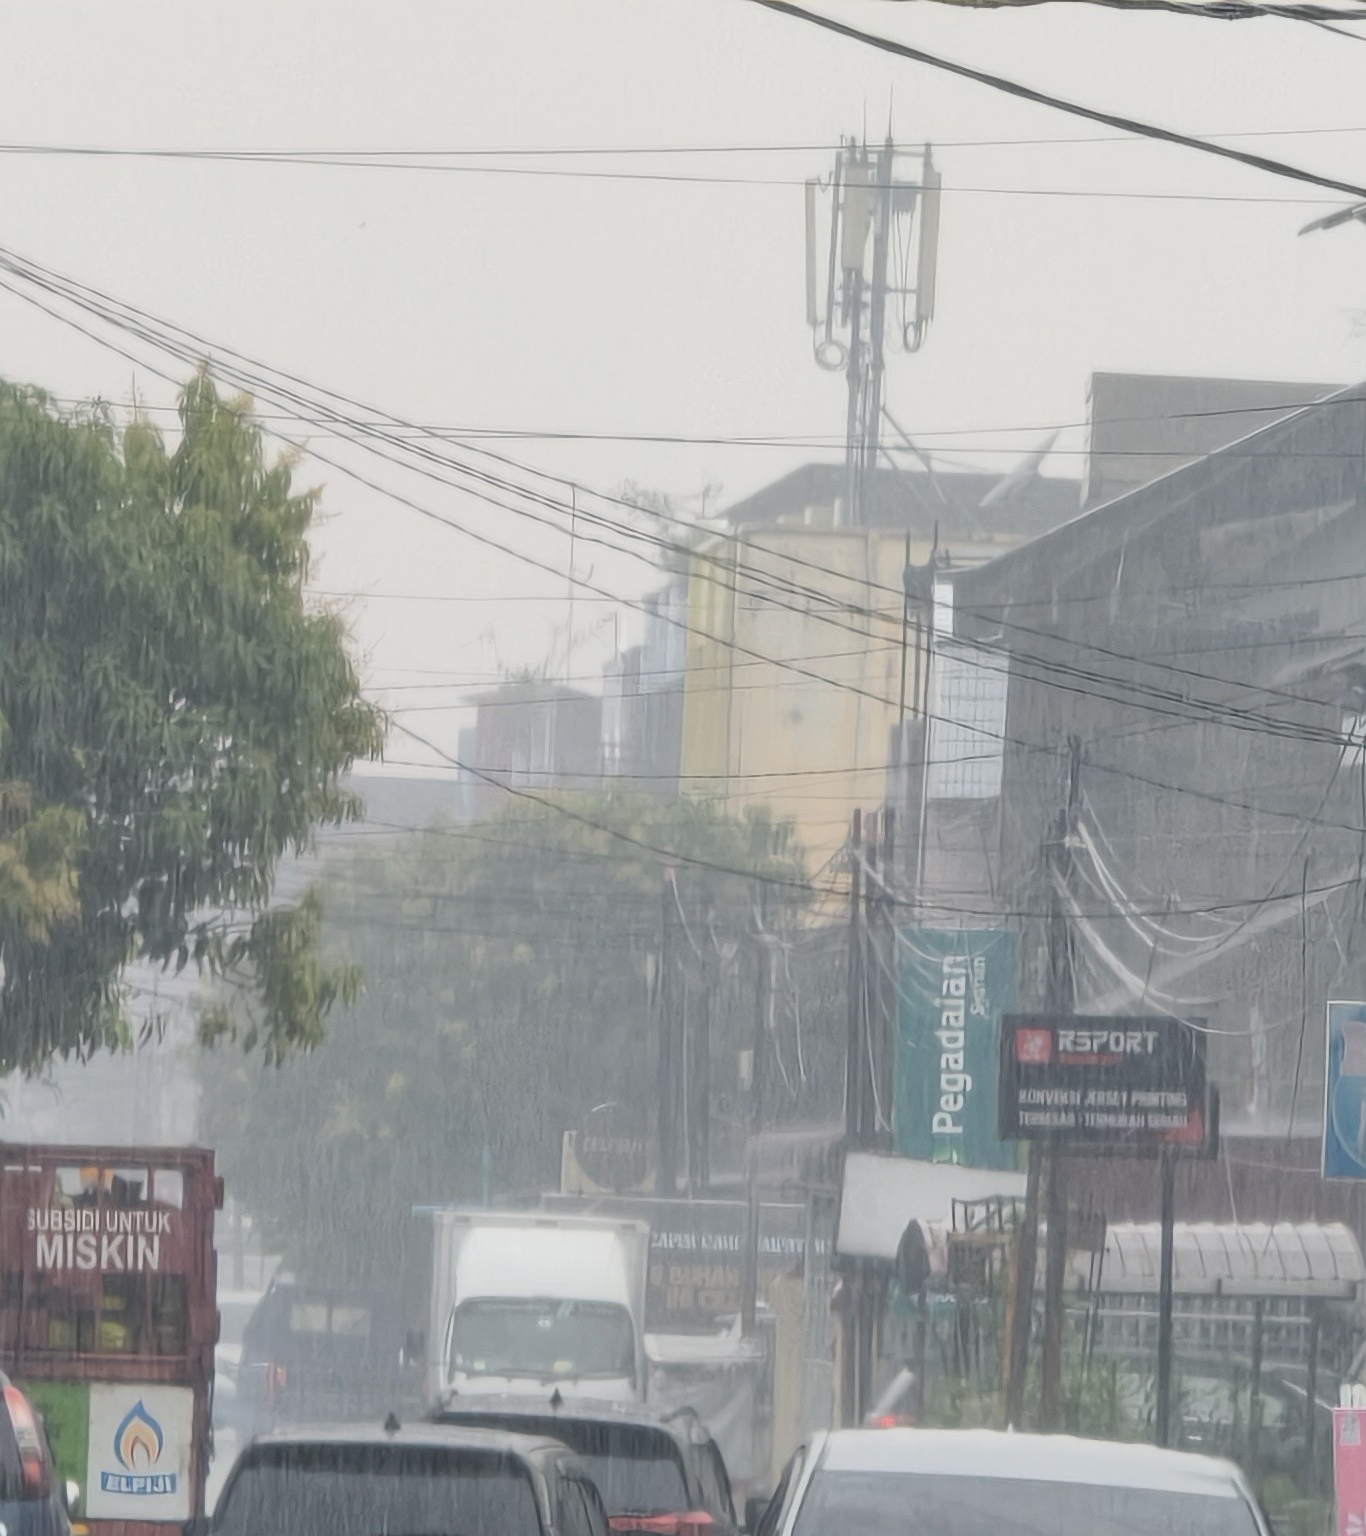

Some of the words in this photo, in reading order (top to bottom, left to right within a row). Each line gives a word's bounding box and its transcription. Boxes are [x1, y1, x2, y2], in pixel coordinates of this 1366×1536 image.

[932, 955, 973, 1134] Pegadaian
[28, 1207, 101, 1233] SUBSIDI
[106, 1209, 172, 1235] UNTUK
[36, 1232, 161, 1272] MISKIN
[106, 1474, 173, 1494] ELPIJI
